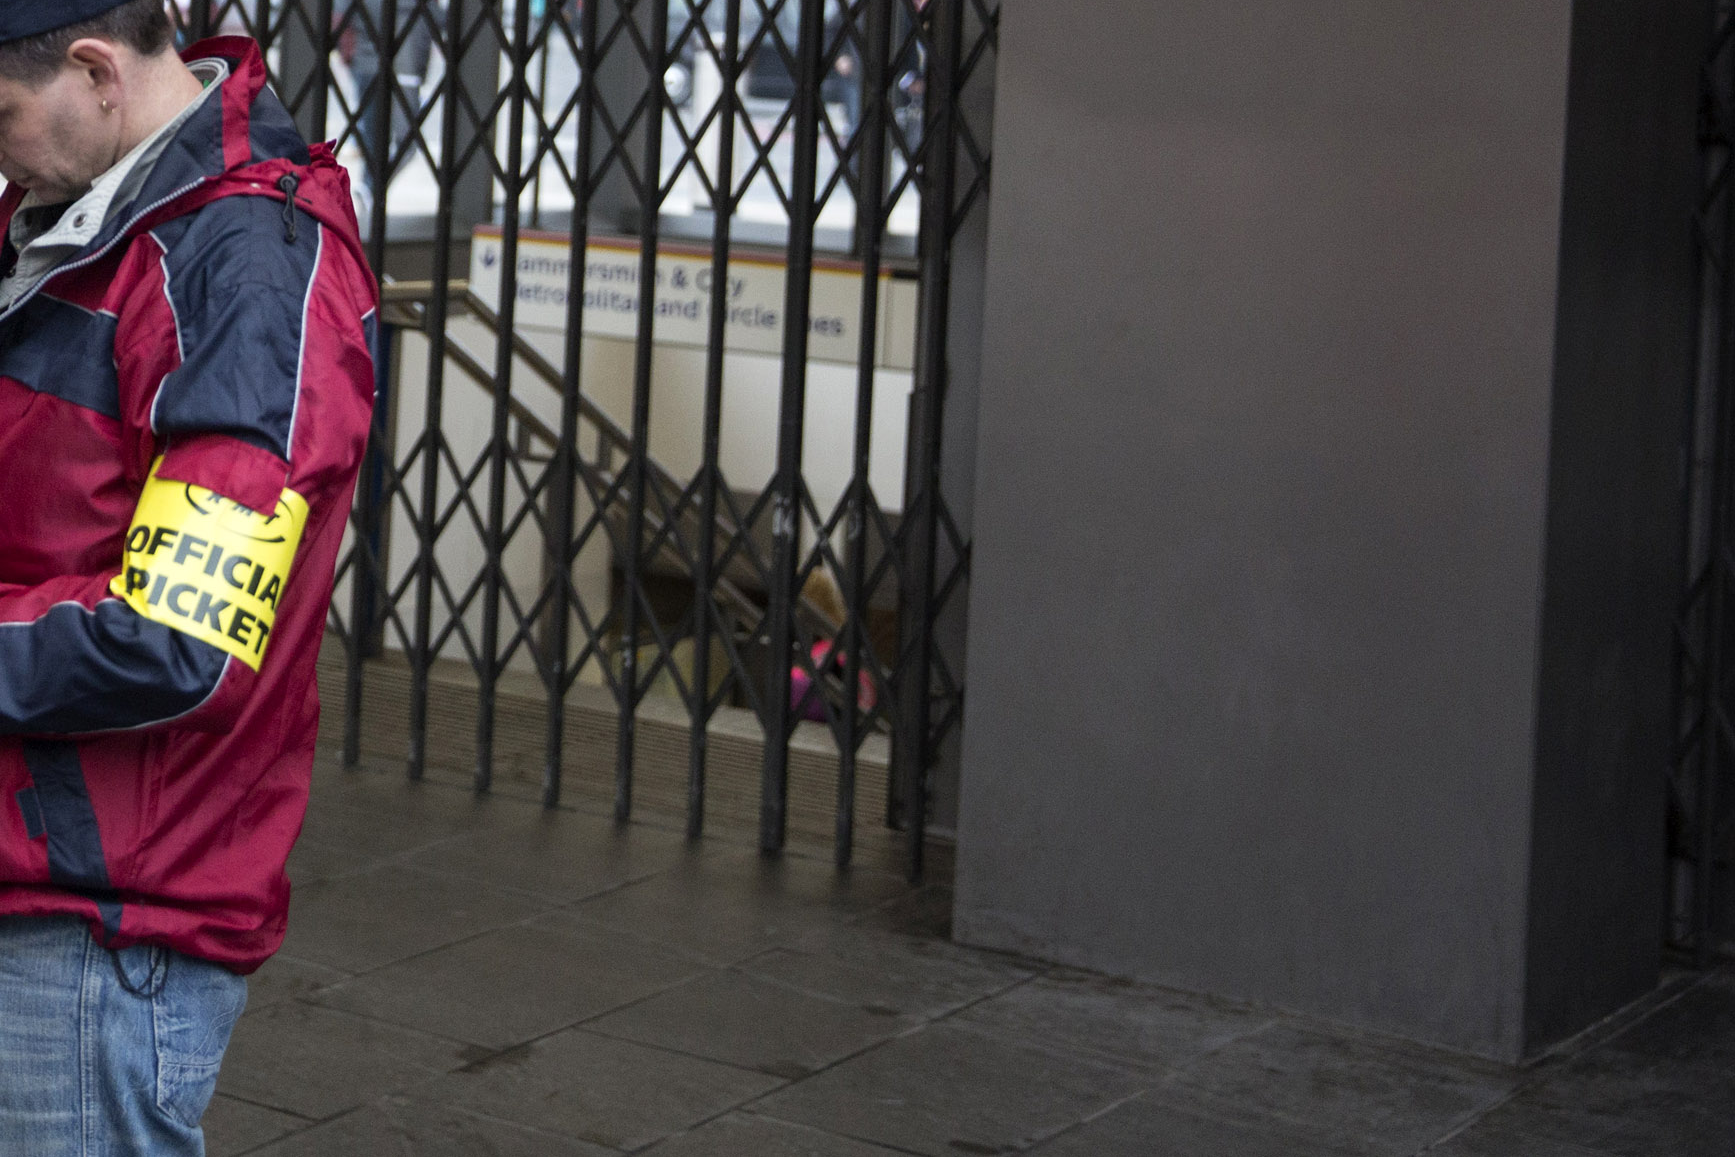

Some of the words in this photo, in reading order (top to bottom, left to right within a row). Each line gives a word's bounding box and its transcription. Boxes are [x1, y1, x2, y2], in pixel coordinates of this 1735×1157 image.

[695, 267, 745, 297] Cy
[125, 525, 282, 611] OFFICIA
[125, 565, 271, 656] PICKET
